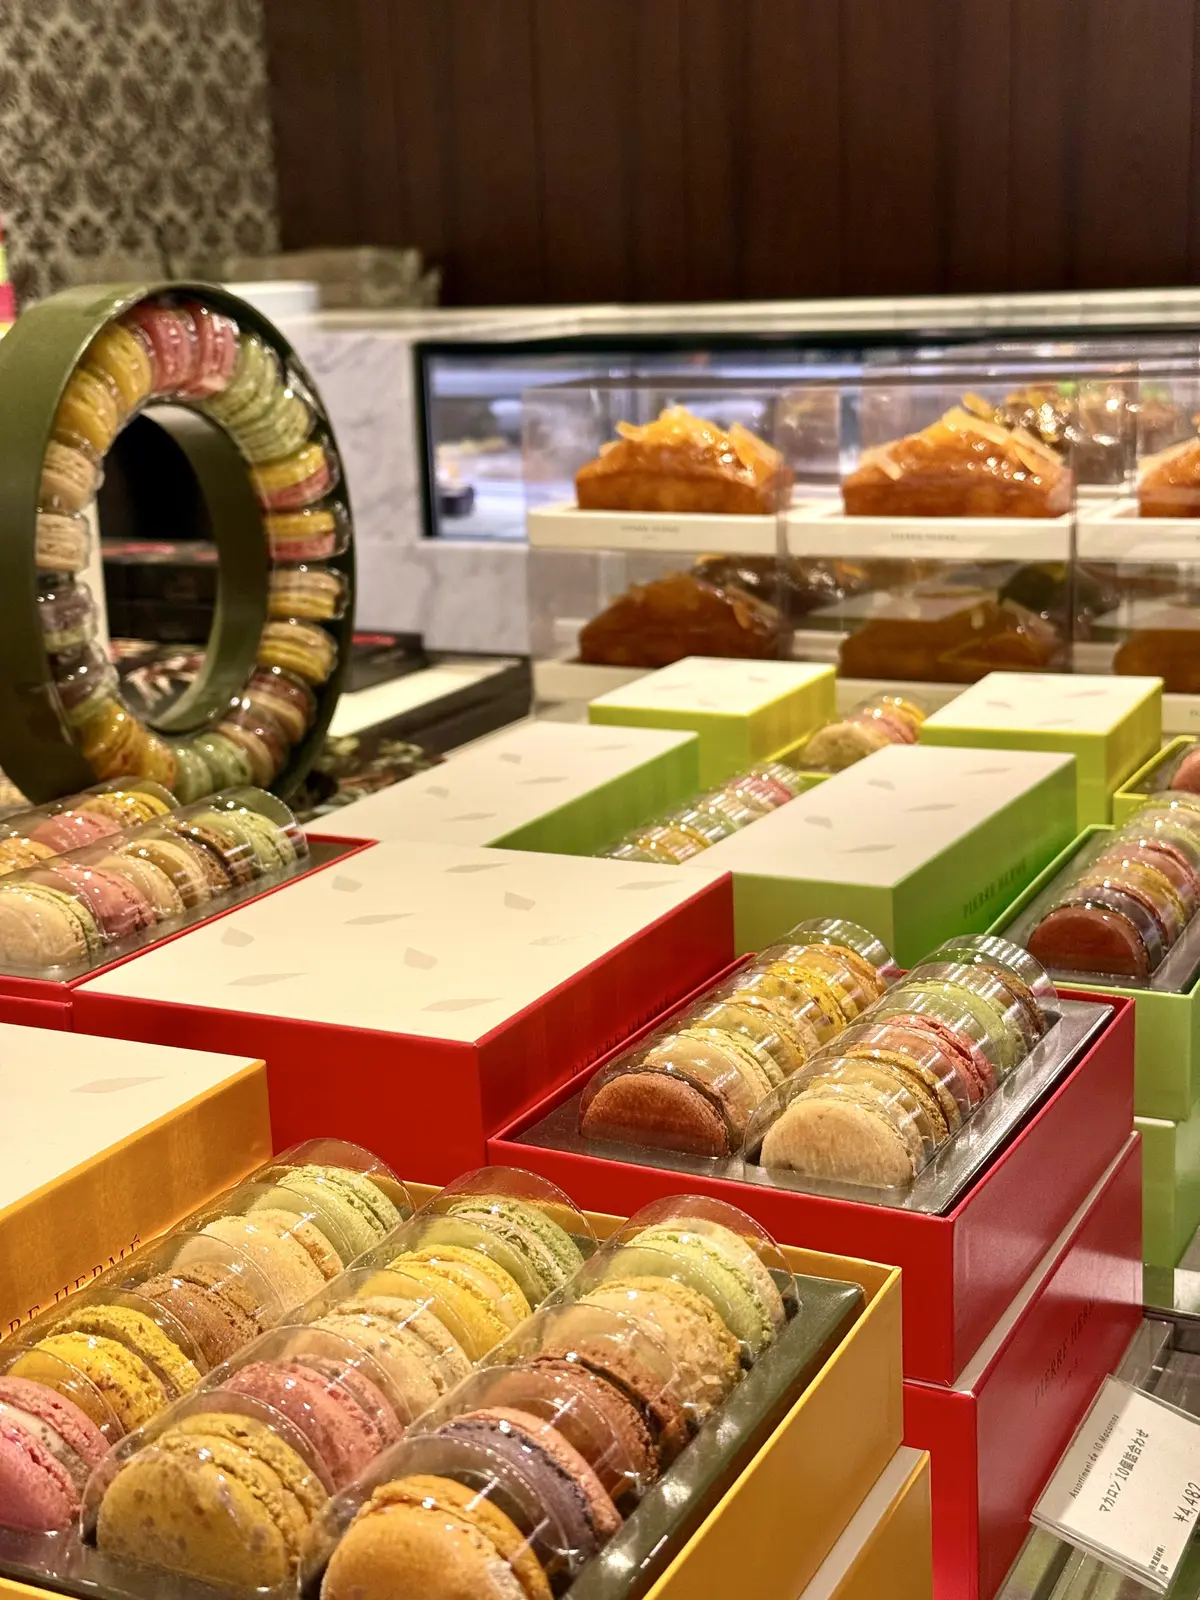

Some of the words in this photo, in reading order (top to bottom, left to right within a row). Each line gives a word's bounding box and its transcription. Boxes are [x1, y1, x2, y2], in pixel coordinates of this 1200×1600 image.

[1093, 1442, 1104, 1452] 10
[1088, 1452, 1099, 1462] de
[1098, 1480, 1122, 1512] マカロン
